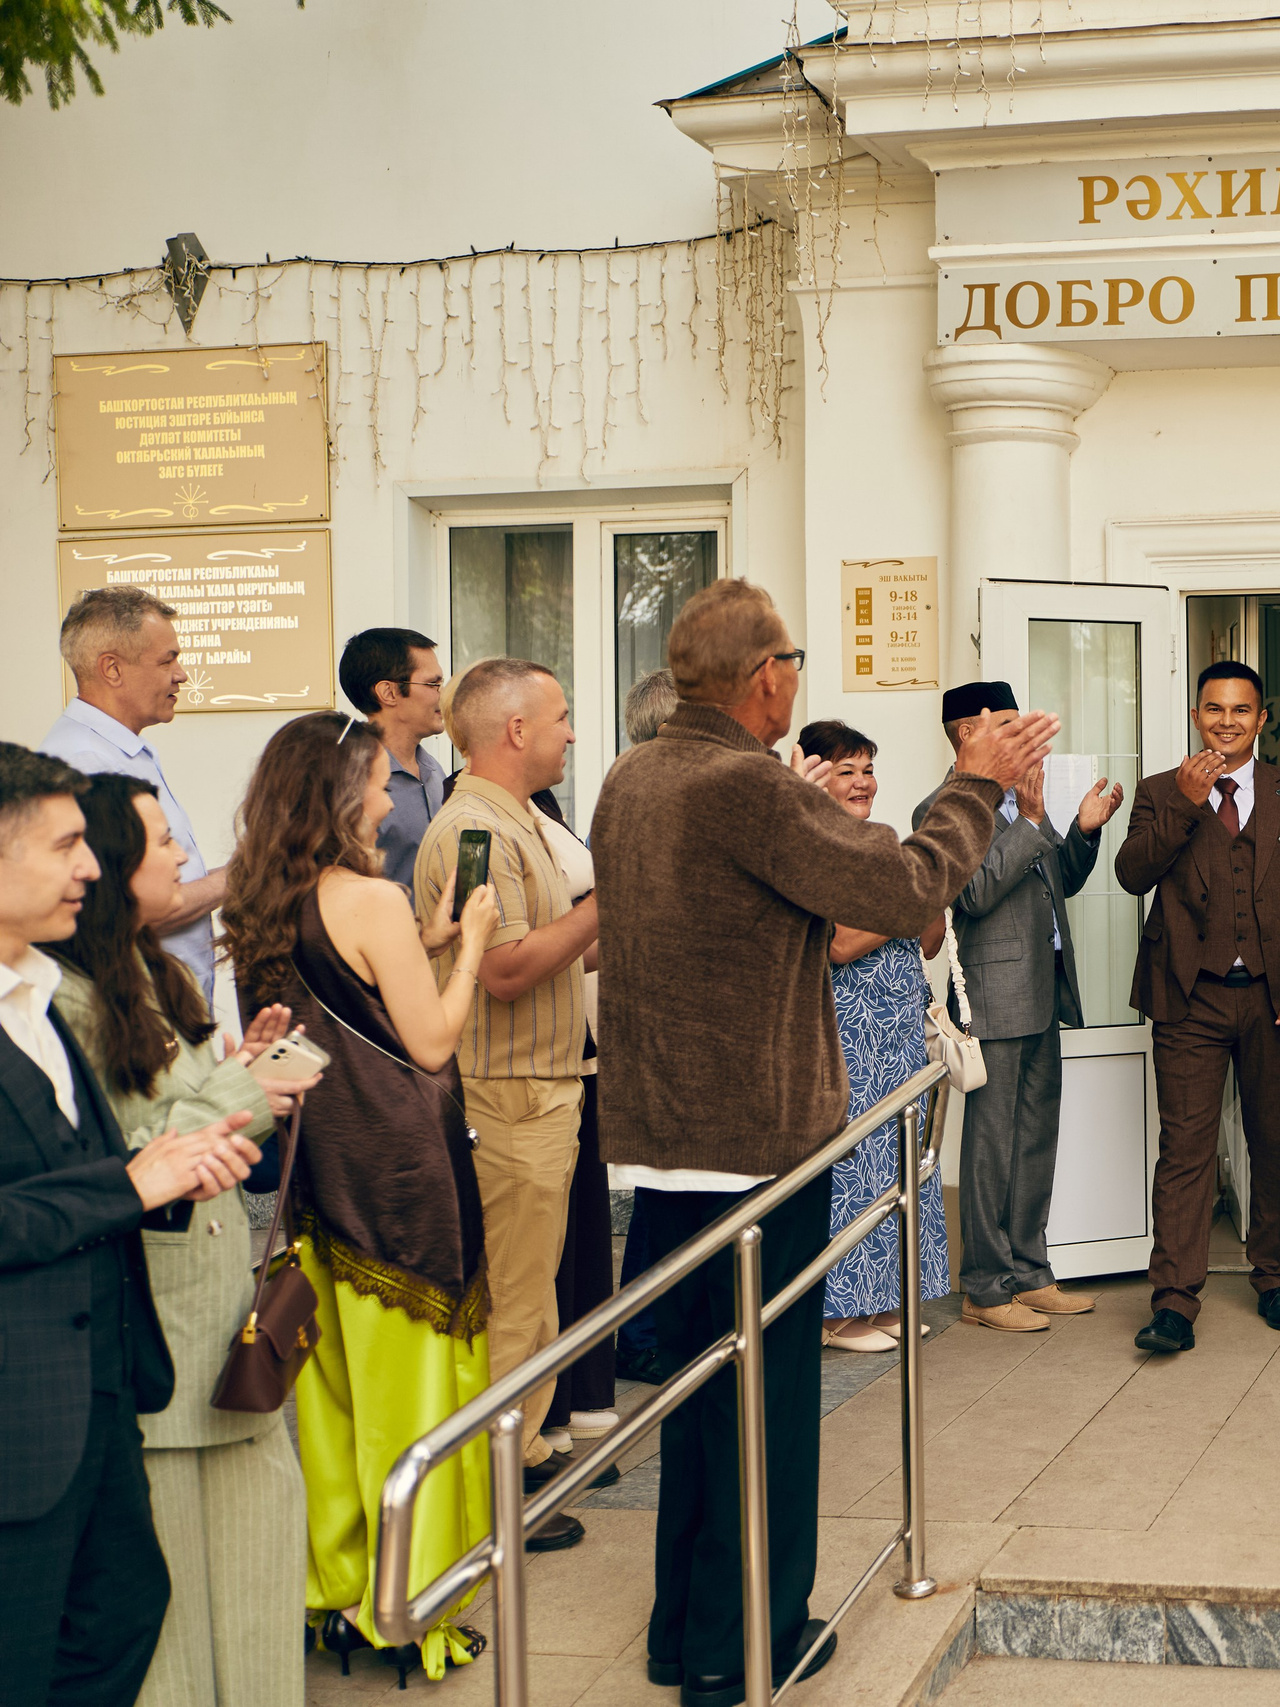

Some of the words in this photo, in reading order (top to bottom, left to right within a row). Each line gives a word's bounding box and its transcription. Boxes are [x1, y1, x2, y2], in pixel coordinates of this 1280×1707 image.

[954, 275, 1195, 342] ДОБРО
[115, 415, 167, 430] ЮСТИЦИЯ
[213, 409, 265, 425] БУЙЫНСА
[183, 428, 241, 443] КОМИТЕТЫ
[116, 446, 191, 464] ОКТЯБРЬСКИЙ
[158, 465, 185, 479] ЗАГС
[879, 575, 891, 583] ЭШ
[889, 590, 918, 602] 9-18
[891, 612, 918, 621] 13-14
[193, 634, 221, 648] БИНА
[889, 631, 918, 643] 9-17
